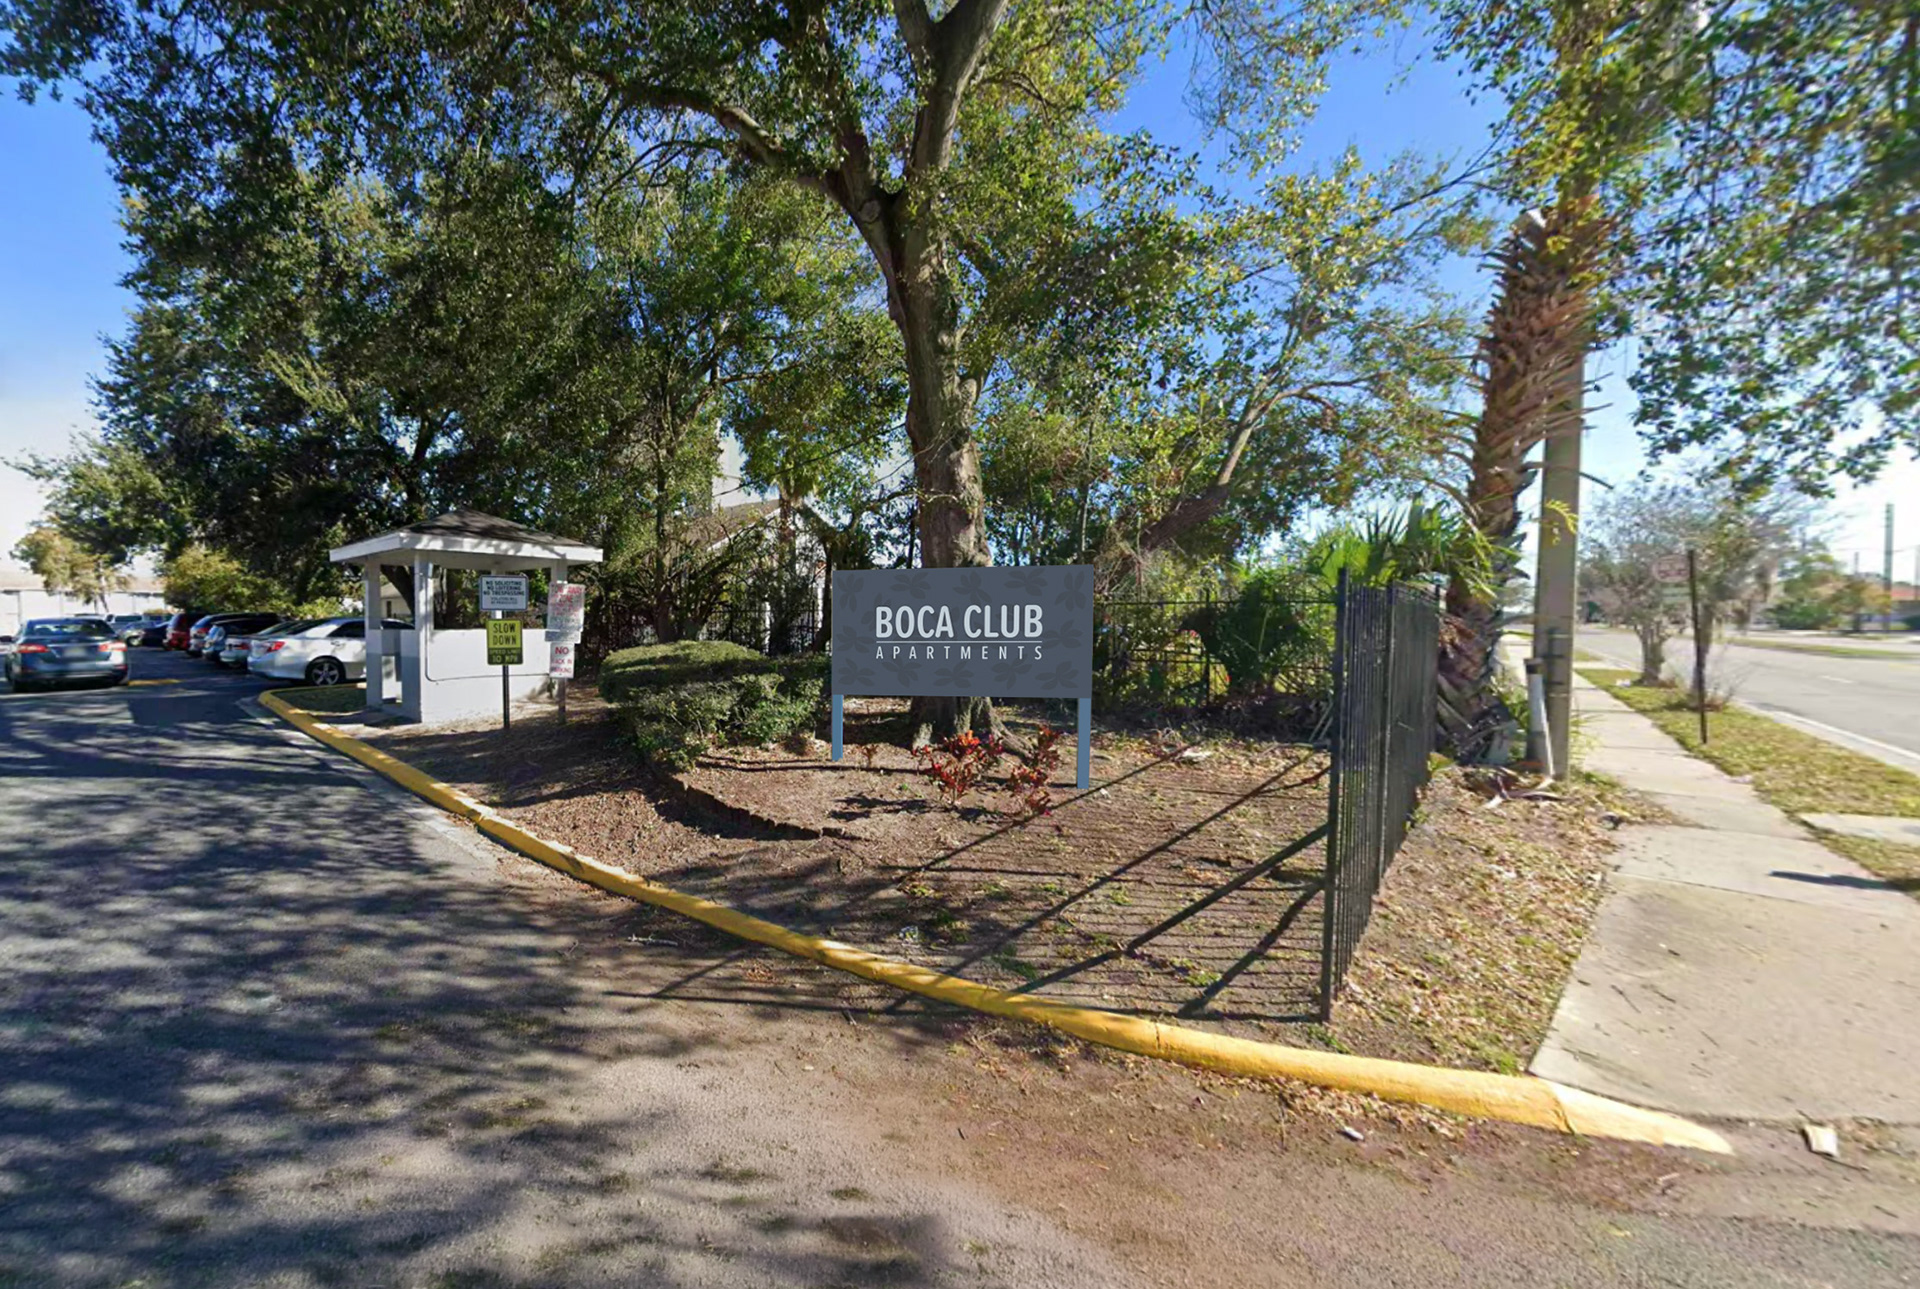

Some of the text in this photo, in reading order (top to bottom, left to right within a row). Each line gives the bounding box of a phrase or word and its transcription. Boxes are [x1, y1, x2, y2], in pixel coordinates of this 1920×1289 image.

[876, 604, 1043, 638] BOCA CLUB
[493, 623, 516, 633] SLOW
[493, 635, 516, 645] DOWN
[555, 646, 570, 654] NO
[876, 646, 1042, 660] APARTMENTS
